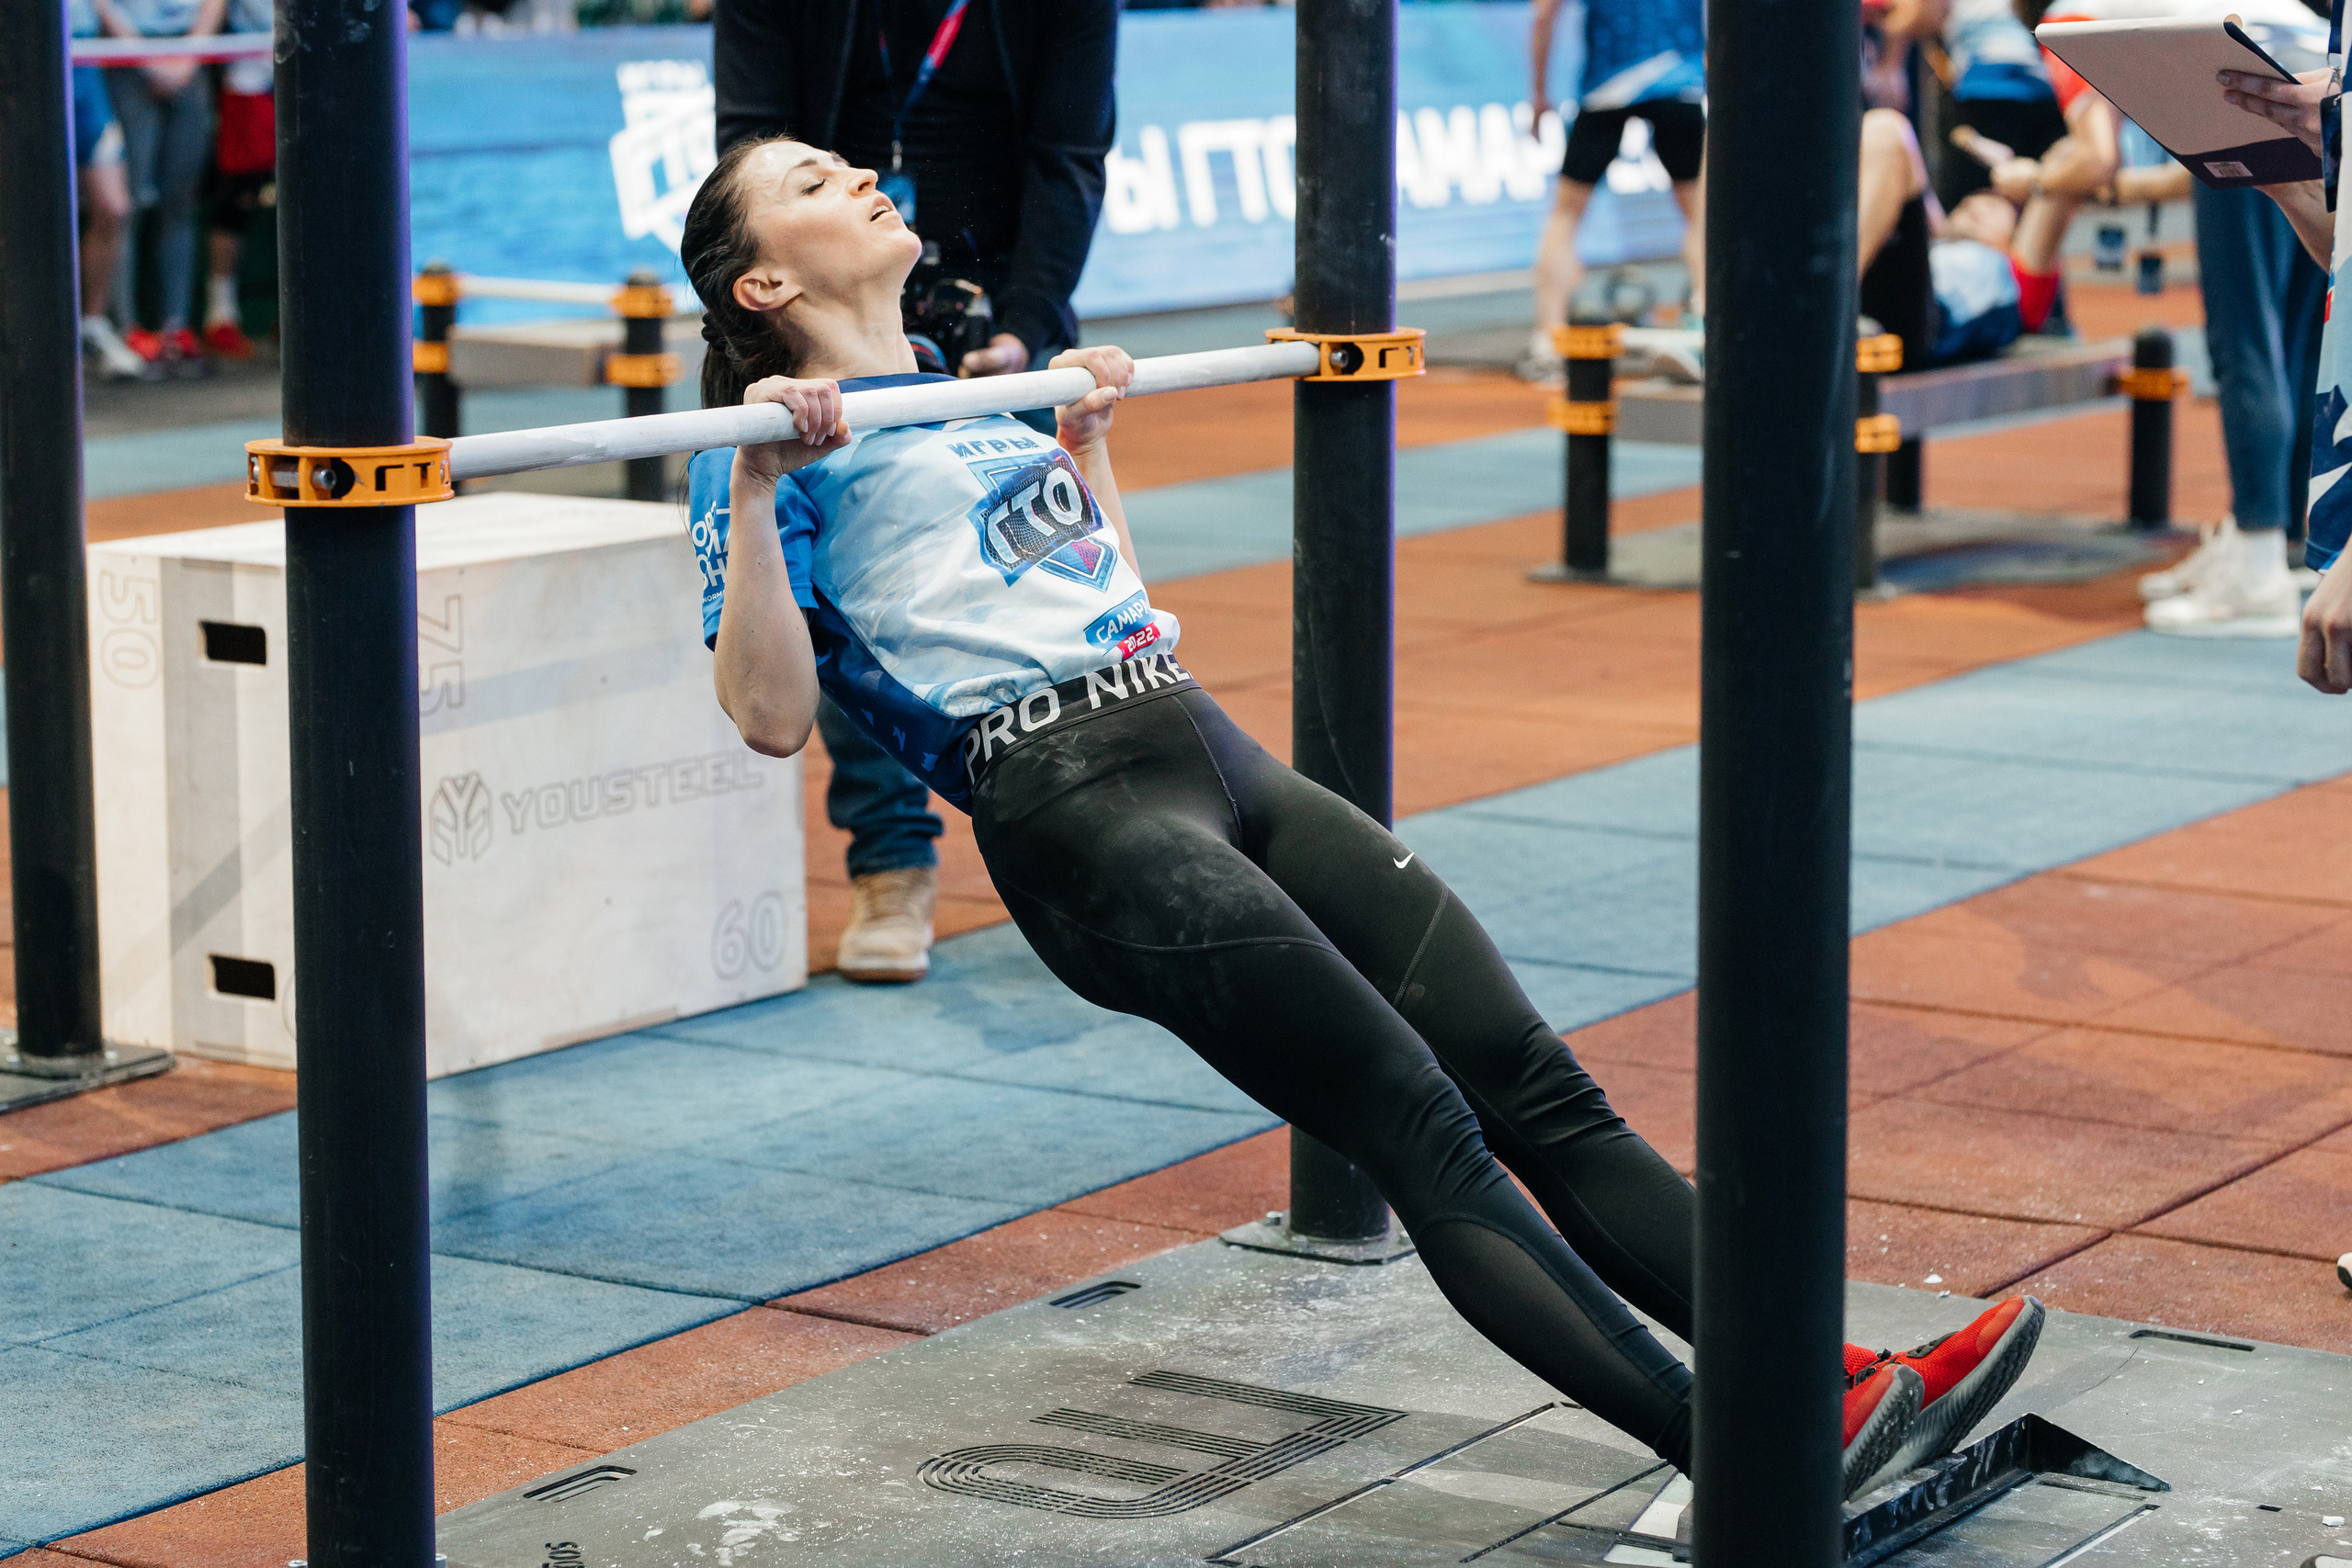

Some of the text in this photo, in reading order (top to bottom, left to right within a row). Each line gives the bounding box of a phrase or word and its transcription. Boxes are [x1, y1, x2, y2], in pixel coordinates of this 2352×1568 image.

[944, 435, 1042, 459] ИГРЫ
[988, 467, 1083, 564] ГТО
[98, 568, 161, 690] 50
[703, 589, 725, 604] NORM
[1124, 626, 1155, 653] 2022
[964, 652, 1193, 789] PRO NIKE
[500, 747, 765, 835] YOUSTEEL
[711, 889, 787, 982] 60
